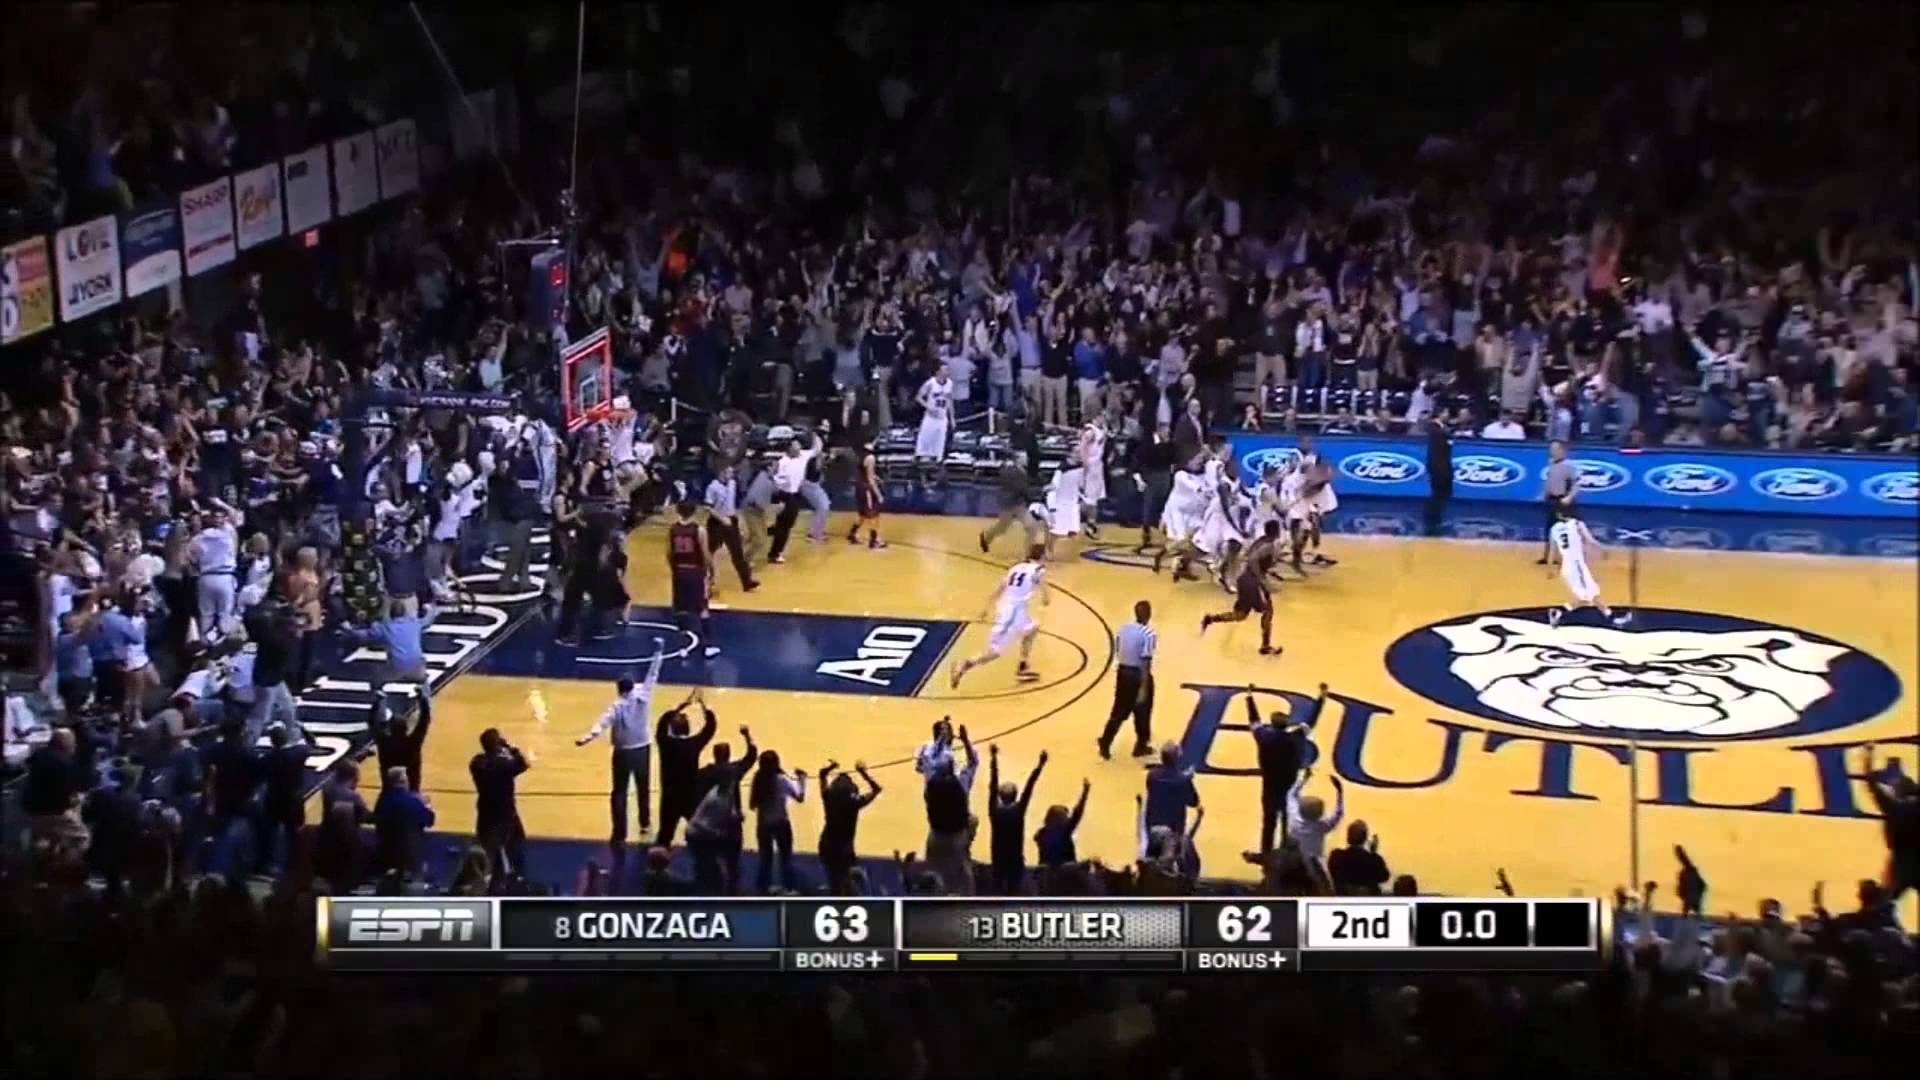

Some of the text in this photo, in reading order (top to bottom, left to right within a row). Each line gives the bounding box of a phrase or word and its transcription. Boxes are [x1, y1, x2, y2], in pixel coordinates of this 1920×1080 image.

[1353, 456, 1408, 478] Ford
[1454, 458, 1510, 482] Ford
[1659, 467, 1721, 492] Ford
[1766, 472, 1830, 497] Ford
